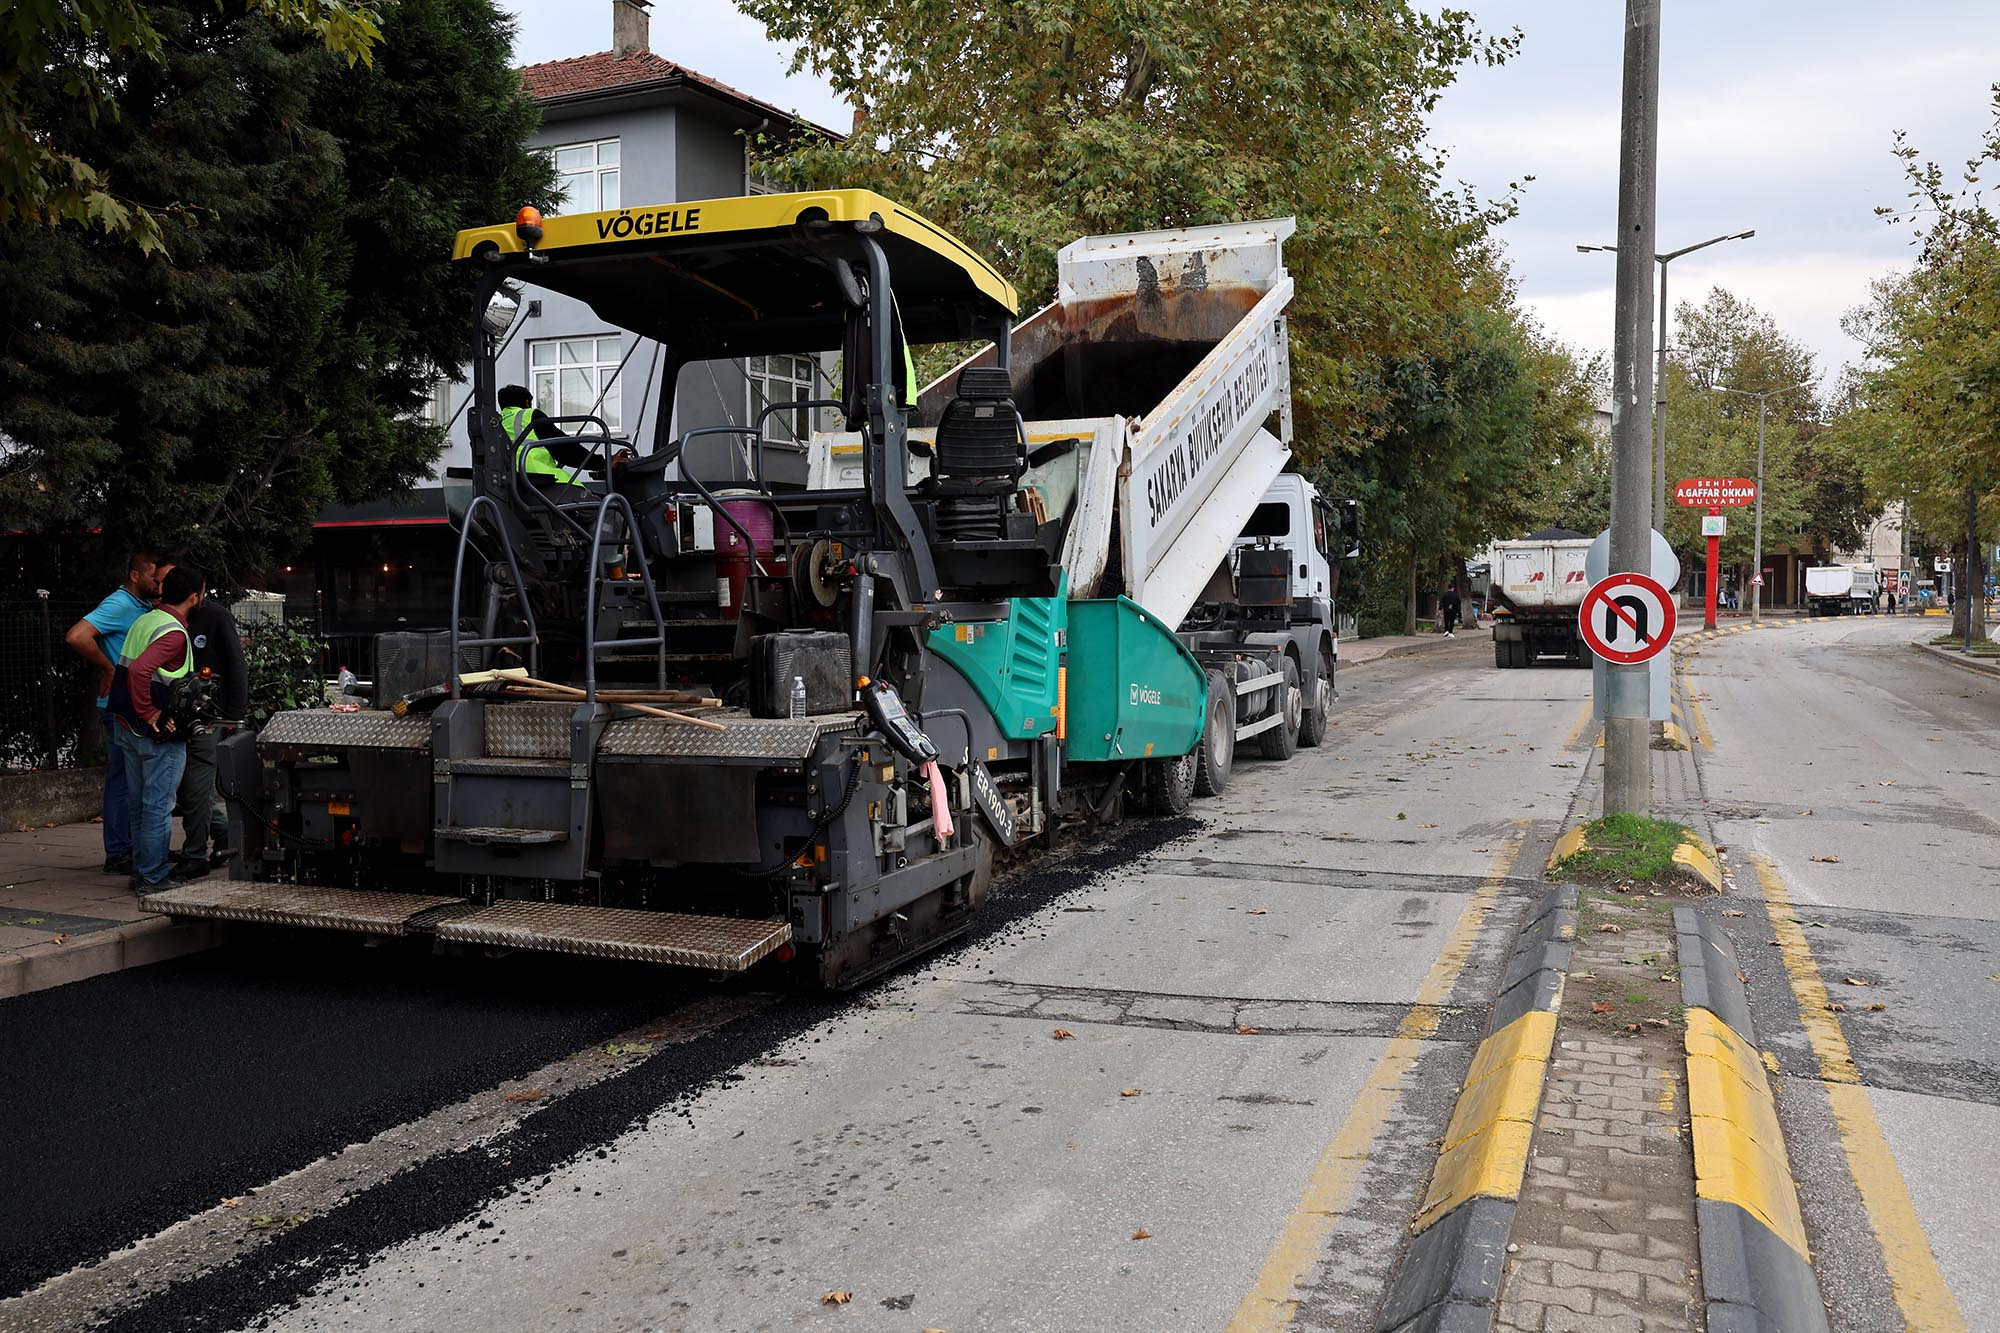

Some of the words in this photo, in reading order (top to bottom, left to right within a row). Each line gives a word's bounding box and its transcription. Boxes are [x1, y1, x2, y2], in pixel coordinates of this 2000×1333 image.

[596, 209, 701, 240] VÖGELE
[1148, 443, 1187, 528] SAKARYA
[1187, 380, 1234, 479] BÜYÜKŞEHİR
[1234, 335, 1270, 422] BELEDİYESİ
[1677, 488, 1720, 497] A.GAFFAR
[1721, 488, 1754, 497] OKKAN
[1140, 685, 1161, 705] VÖGELE
[988, 789, 1013, 837] 1900-3
